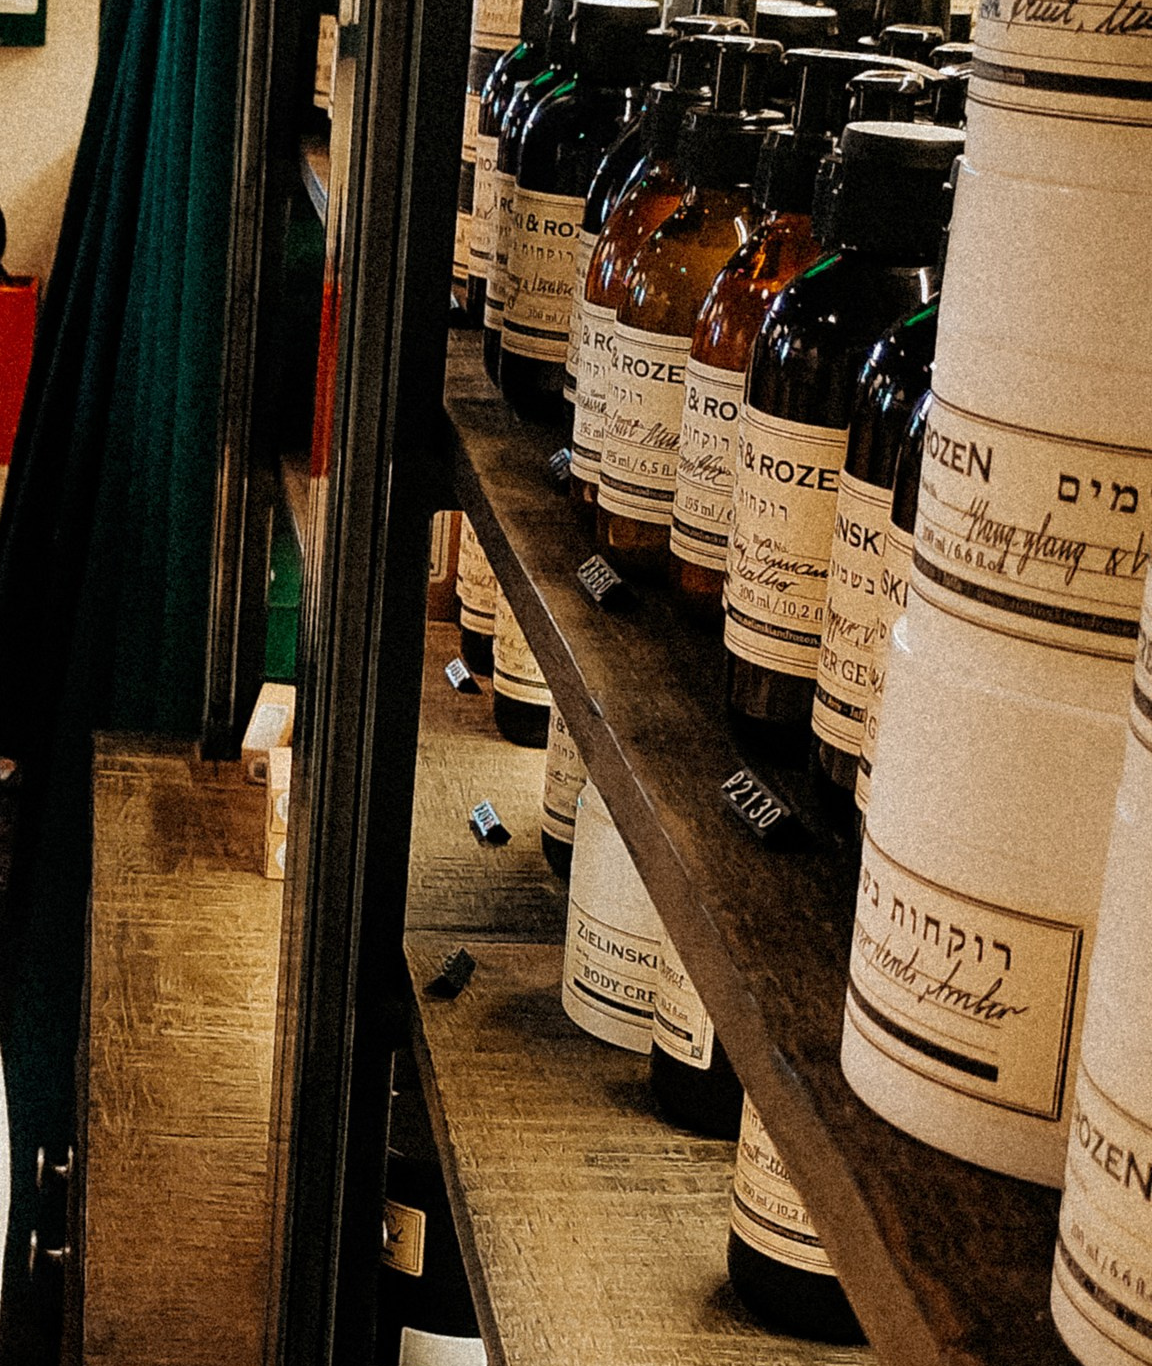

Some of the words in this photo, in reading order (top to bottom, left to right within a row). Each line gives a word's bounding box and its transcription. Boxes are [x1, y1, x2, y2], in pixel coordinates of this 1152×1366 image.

[688, 386, 699, 412] &
[759, 453, 840, 494] ROZE
[577, 918, 658, 970] ZIELINSKI
[583, 965, 620, 993] BODY
